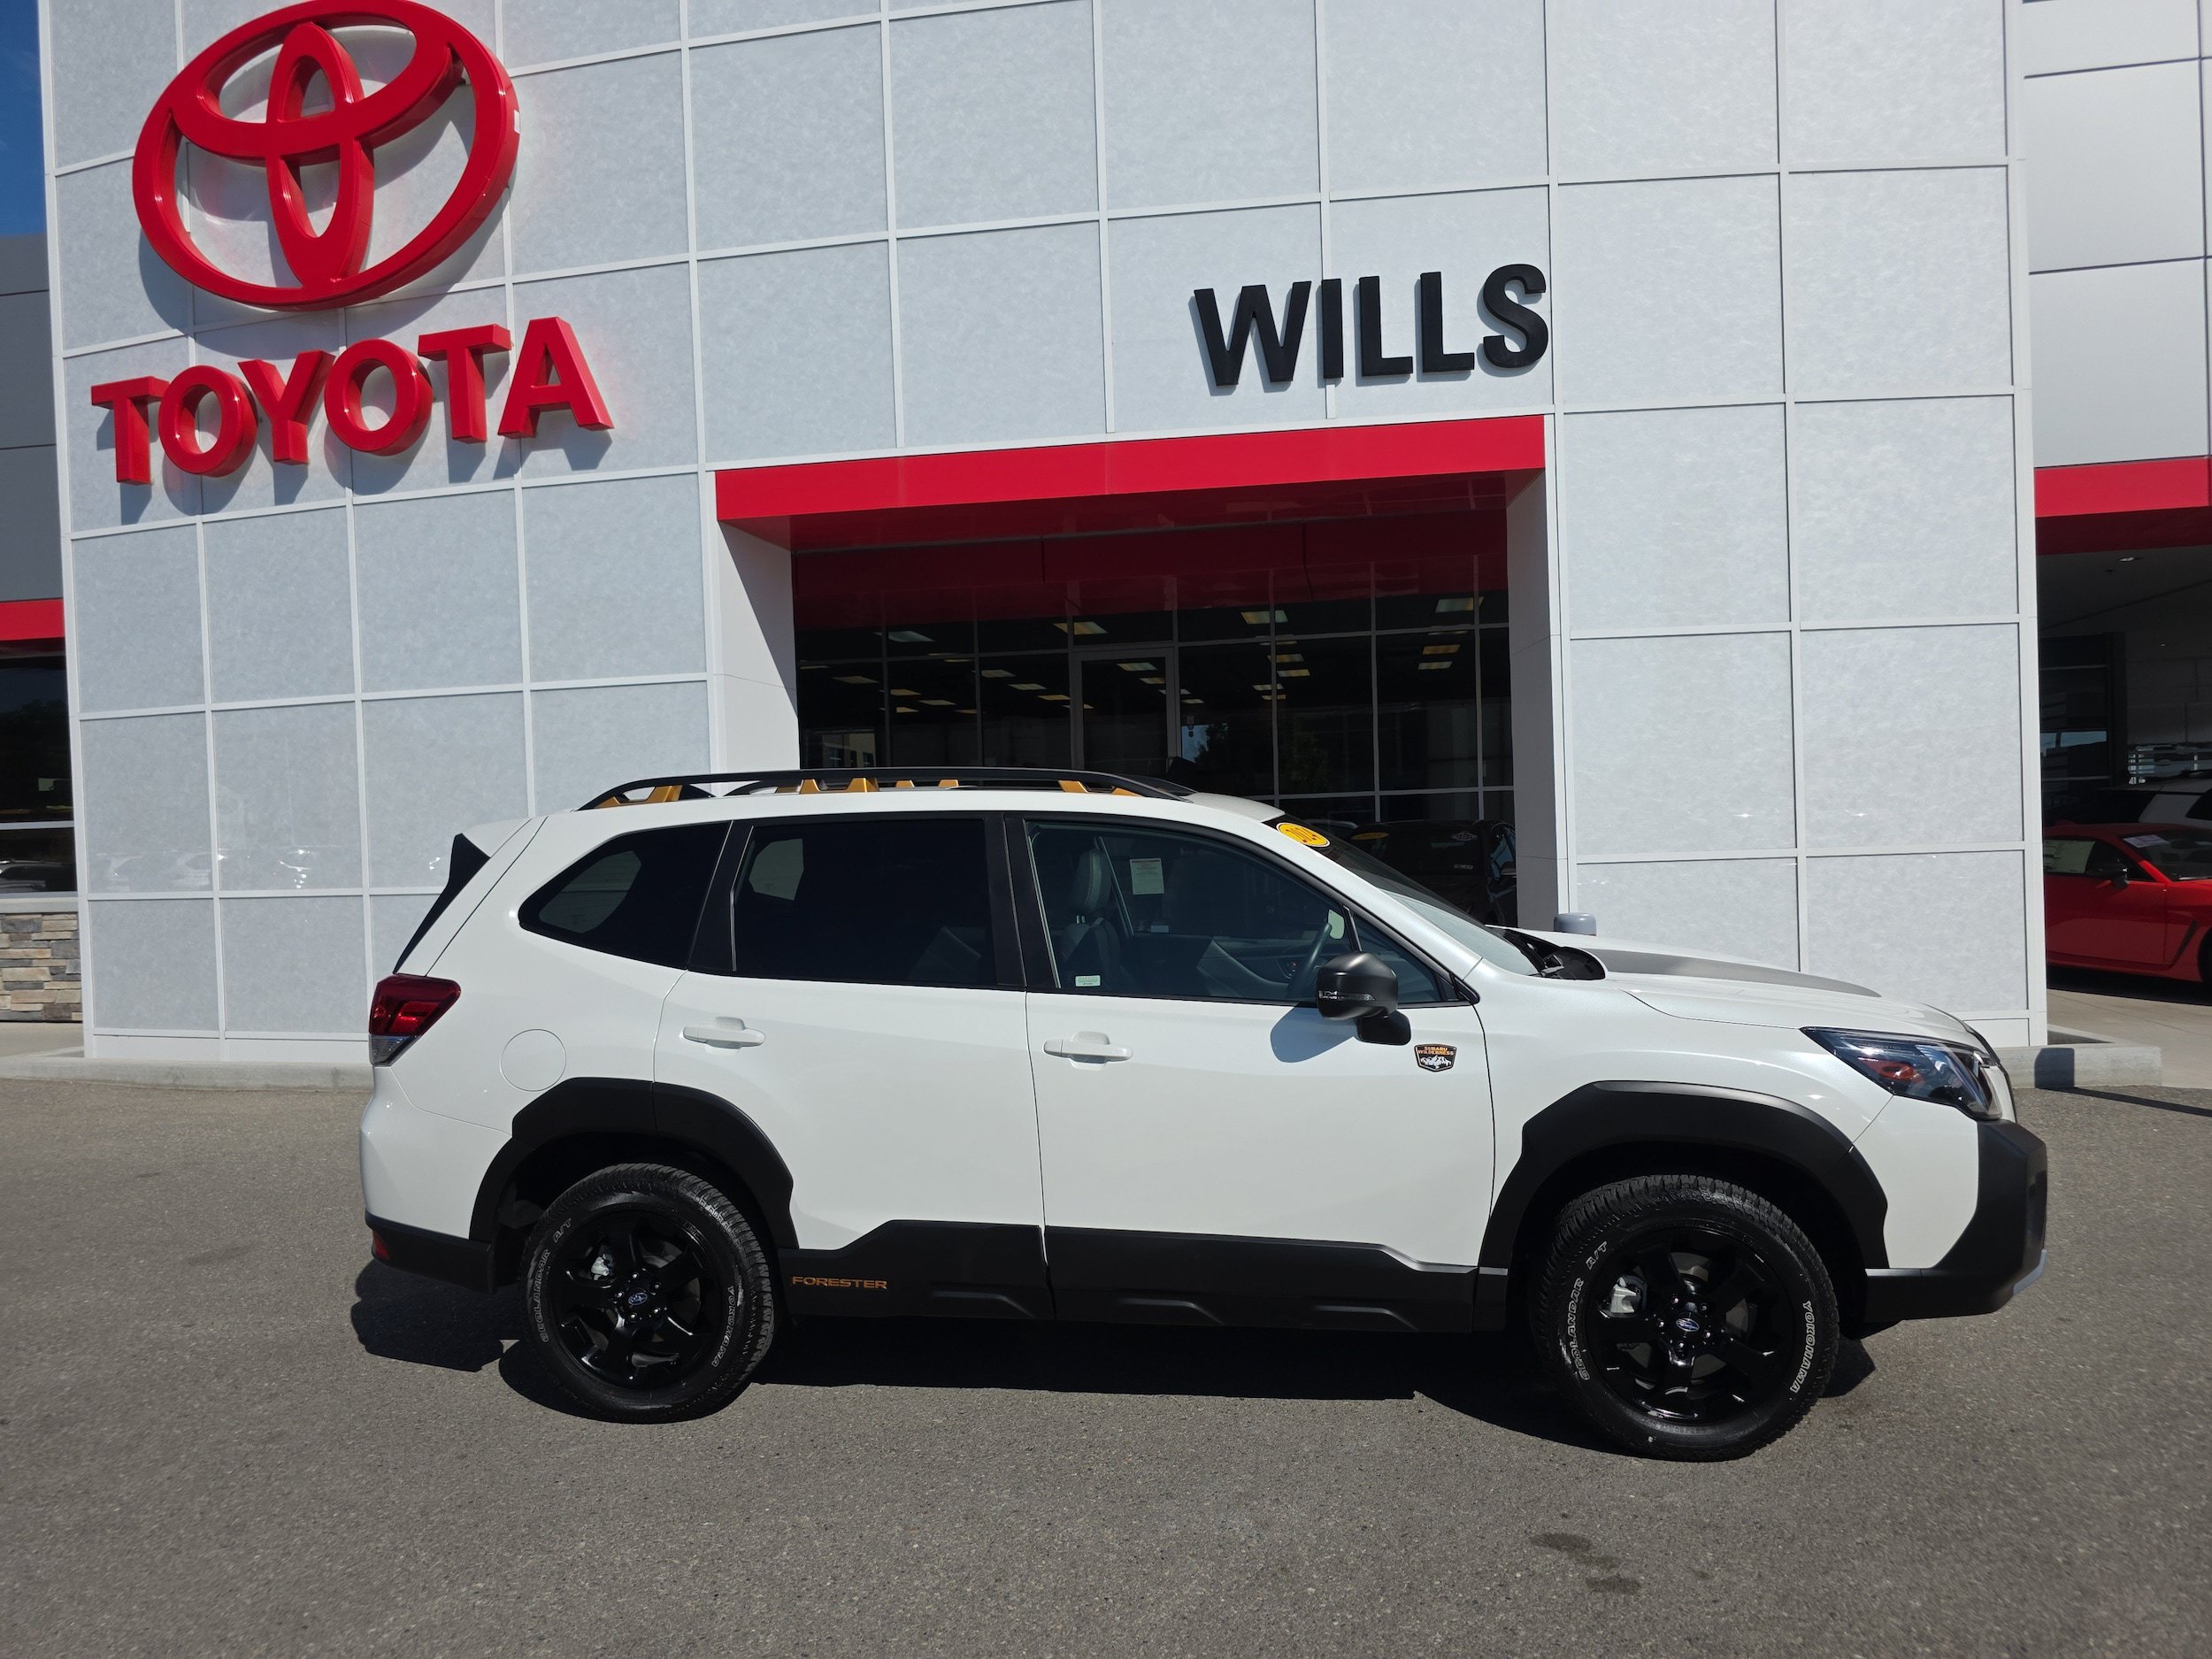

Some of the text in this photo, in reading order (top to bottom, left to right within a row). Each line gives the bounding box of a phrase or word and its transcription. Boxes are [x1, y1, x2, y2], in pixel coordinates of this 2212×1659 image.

[1194, 264, 1549, 387] WILLS
[91, 317, 614, 486] TOYOTA
[792, 1276, 887, 1289] FORESTER
[1567, 1240, 1608, 1381] GEOLANDAR A/T
[1789, 1300, 1816, 1394] YOKOHAMA
